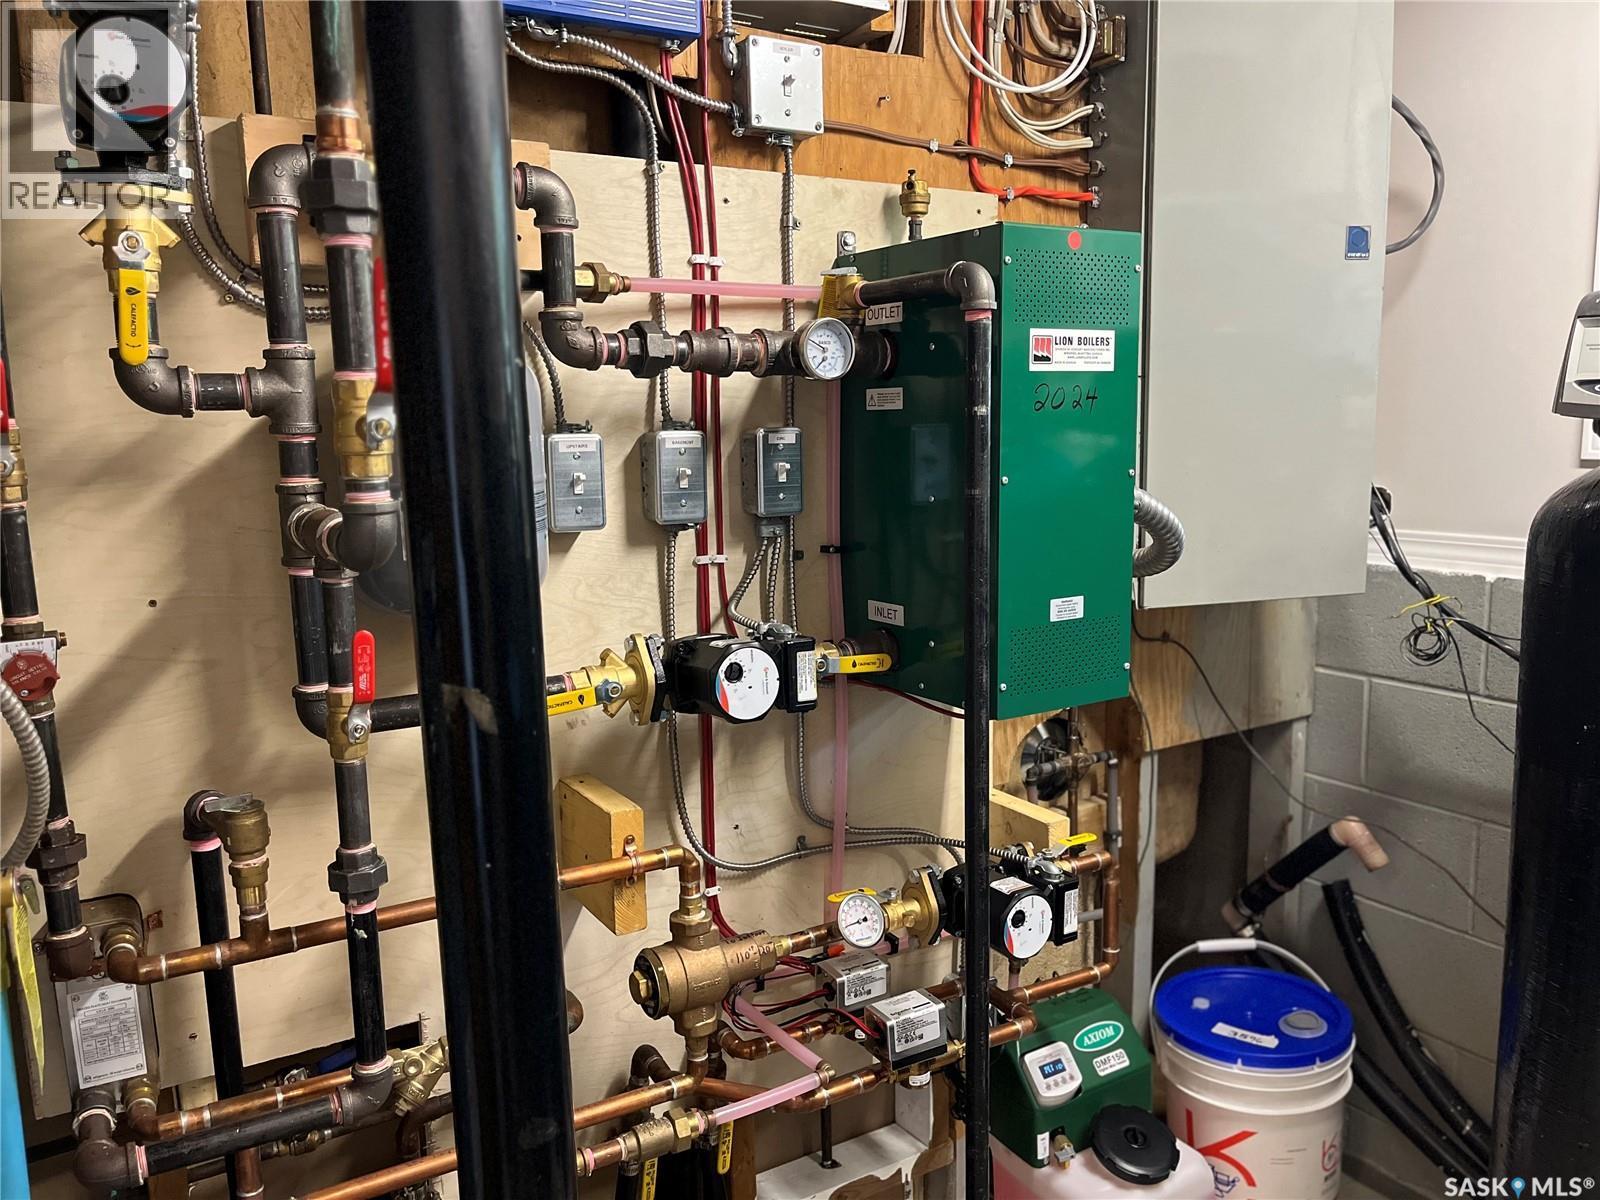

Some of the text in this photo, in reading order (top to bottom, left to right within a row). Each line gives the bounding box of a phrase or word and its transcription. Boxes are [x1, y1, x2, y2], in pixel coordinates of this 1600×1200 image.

[867, 305, 901, 320] OUTLET
[1054, 336, 1110, 346] LION BOILERS
[1034, 383, 1098, 413] 2024
[874, 605, 898, 620] INLET
[1084, 1026, 1115, 1046] AXIOM
[1095, 1051, 1125, 1069] DMF150
